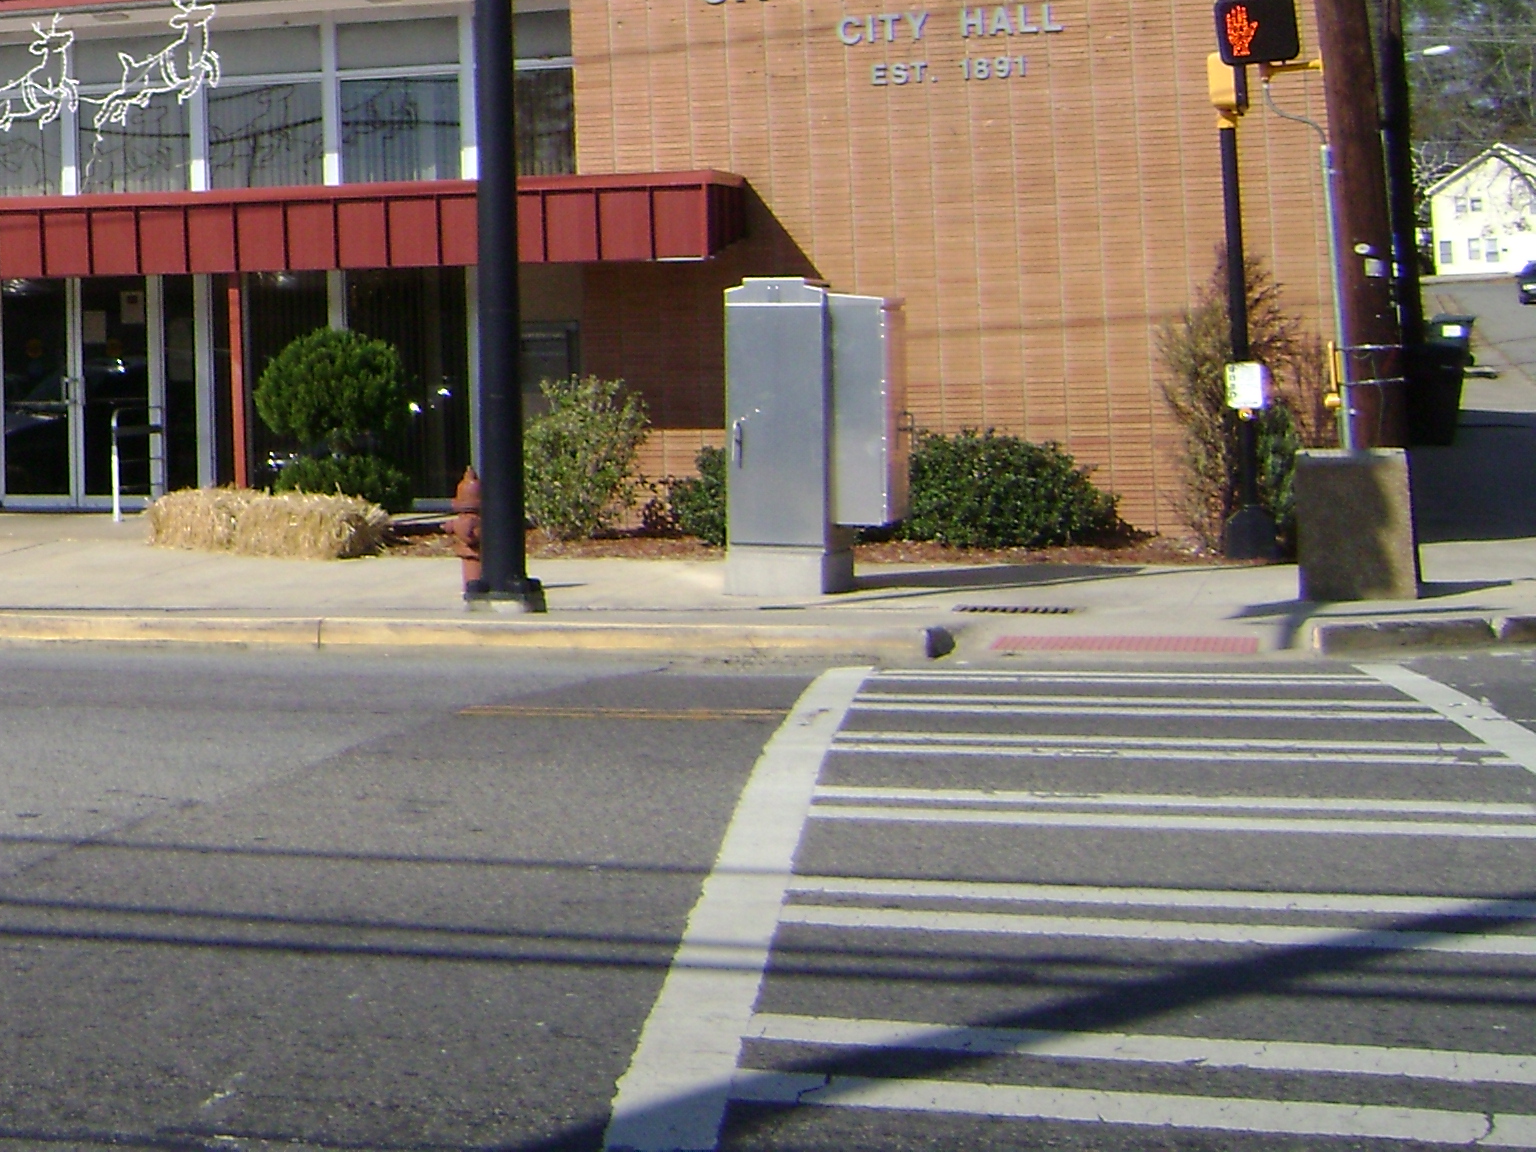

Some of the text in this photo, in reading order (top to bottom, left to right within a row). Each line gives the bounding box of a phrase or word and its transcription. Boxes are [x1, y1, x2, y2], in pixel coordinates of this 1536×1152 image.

[836, 3, 1063, 46] CITY HALL
[871, 55, 1027, 86] EST. 1891
